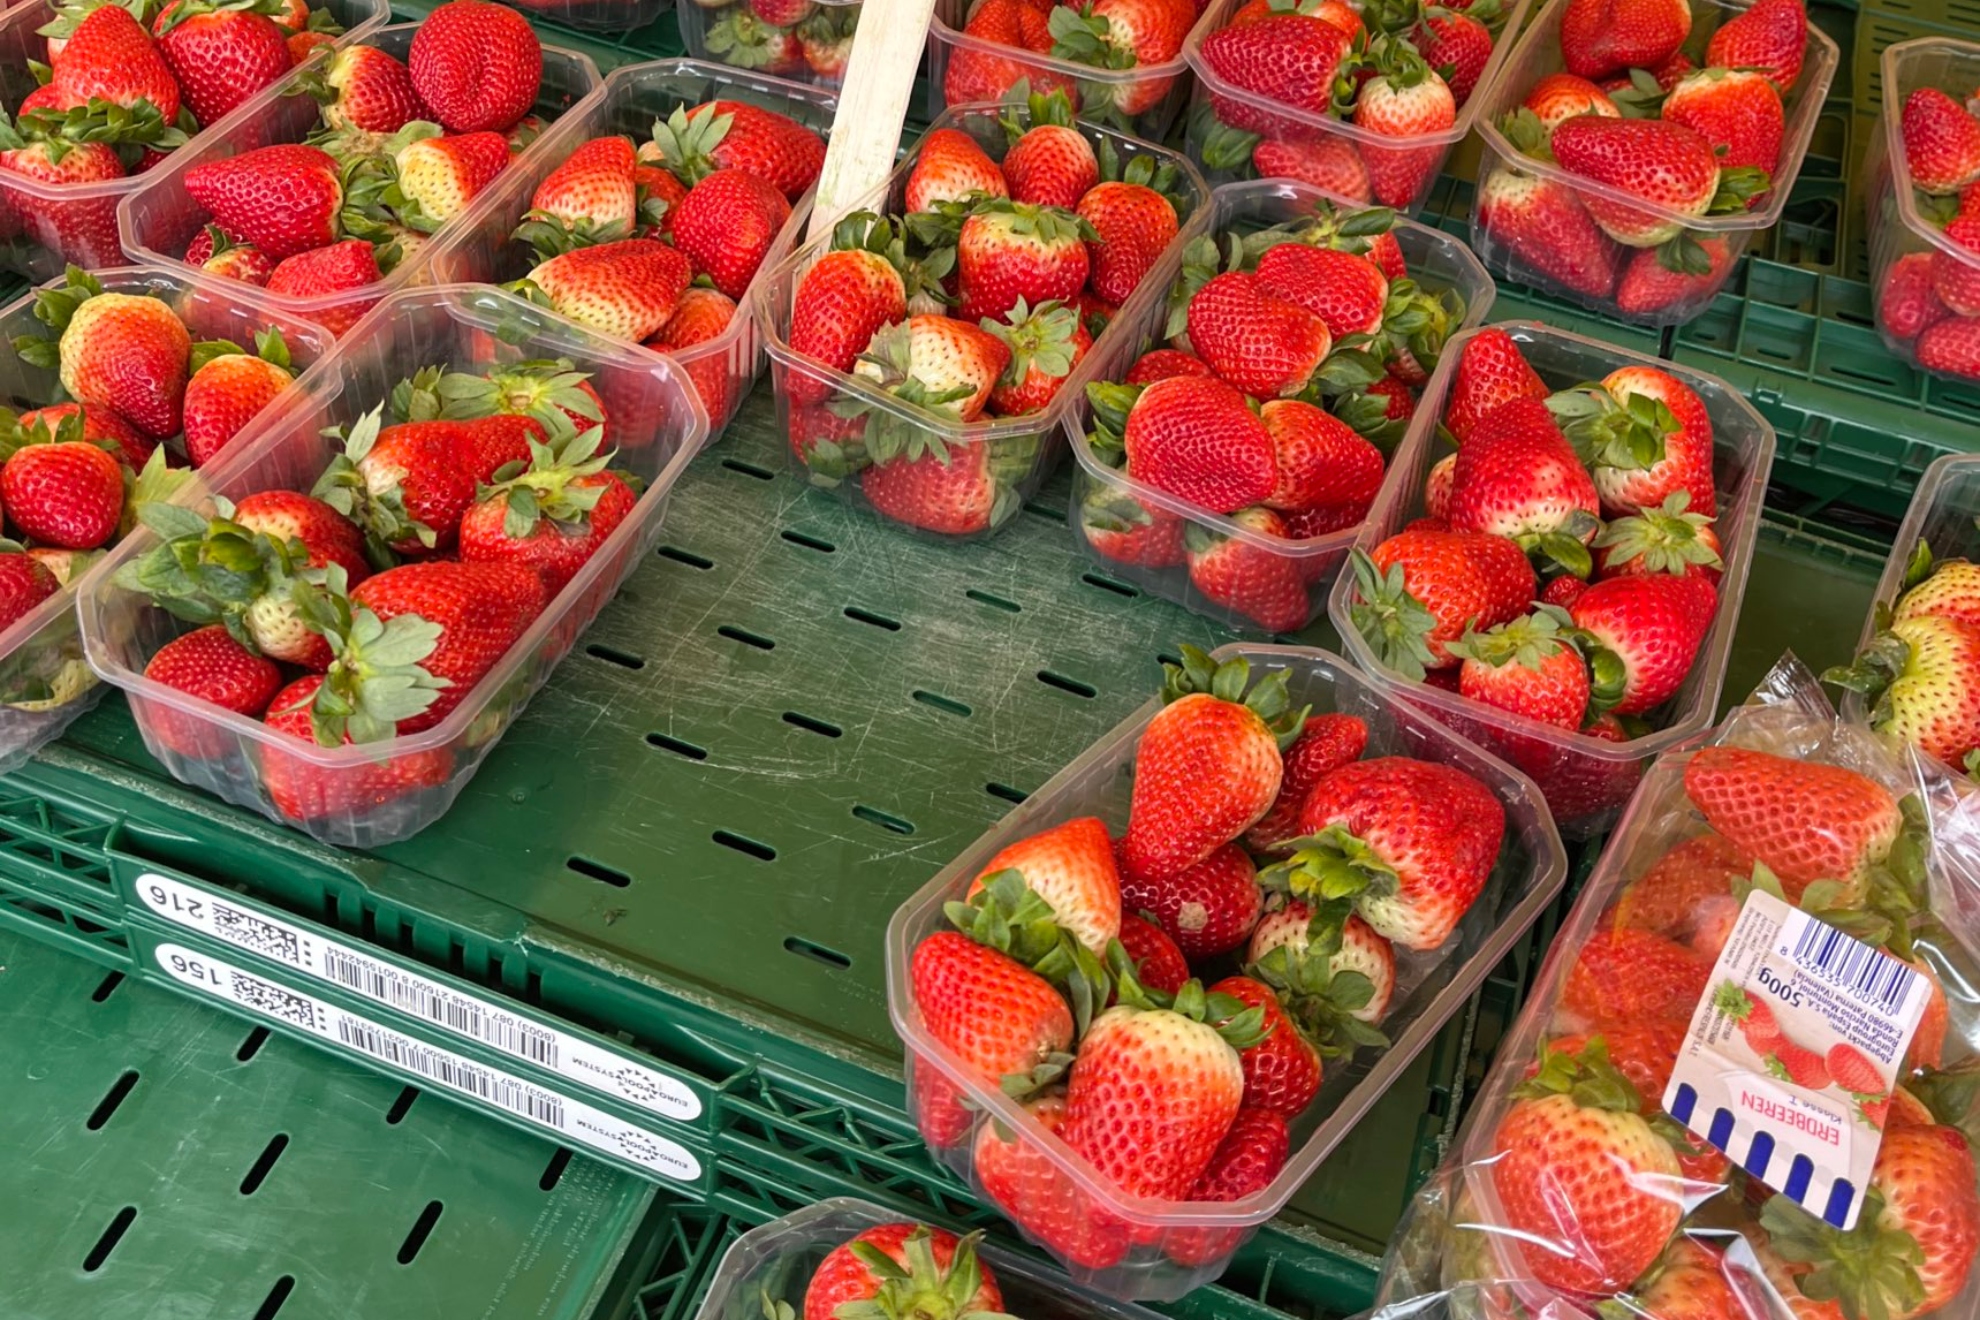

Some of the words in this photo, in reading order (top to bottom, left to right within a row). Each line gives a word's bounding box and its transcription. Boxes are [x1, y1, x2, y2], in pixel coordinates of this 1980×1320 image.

[150, 885, 204, 919] 216
[171, 954, 222, 985] 156
[402, 975, 409, 984] 8
[412, 980, 448, 1000] 21600
[1758, 967, 1805, 1008] 500g
[1779, 946, 1788, 956] 8
[1795, 955, 1841, 987] 436535
[1846, 984, 1895, 1017] 700740
[1794, 969, 1836, 999] (Valencia)
[452, 995, 487, 1016] 14548
[1836, 994, 1868, 1019] Paterna
[493, 1012, 514, 1026] 087
[1822, 1006, 1852, 1030] España
[1829, 1022, 1847, 1036] von:
[1840, 1007, 1870, 1032] Narciso
[1868, 1014, 1904, 1039] E-46980
[518, 1020, 556, 1043] (8003)
[1852, 1023, 1895, 1057] Eurogroup
[1871, 1024, 1900, 1048] Ronda
[423, 1047, 457, 1066] 15600
[1847, 1031, 1892, 1065] Abgepackt
[461, 1061, 496, 1080] 14548
[572, 1057, 614, 1078] SYSTEM
[501, 1077, 521, 1091] 087
[622, 1077, 650, 1093] POOL
[525, 1085, 562, 1106] (8003)
[659, 1092, 688, 1107] EURO
[1742, 1090, 1839, 1146] ERDBEEREN
[1803, 1099, 1842, 1125] Klasse
[577, 1119, 617, 1139] SYSTEM
[626, 1139, 651, 1154] POOL
[659, 1153, 688, 1169] EURO
